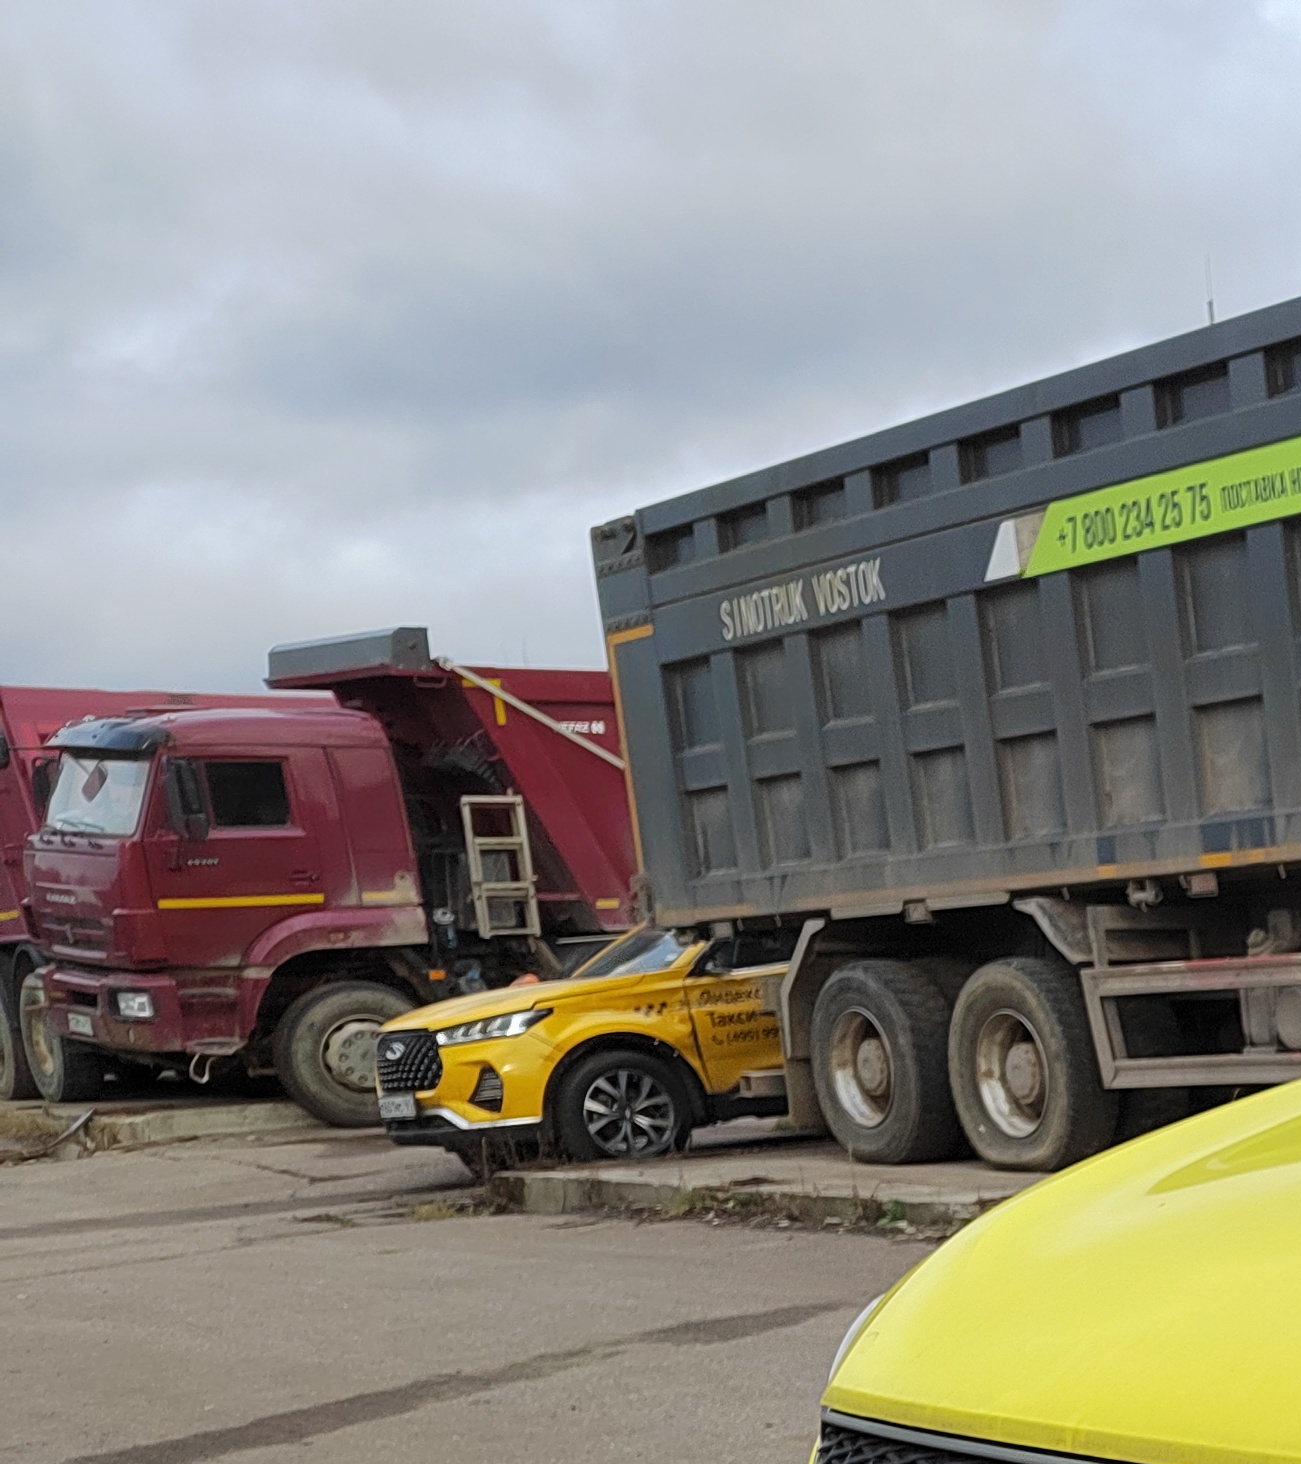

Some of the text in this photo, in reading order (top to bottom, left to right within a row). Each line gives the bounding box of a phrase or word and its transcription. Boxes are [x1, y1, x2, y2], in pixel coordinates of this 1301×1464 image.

[1057, 515, 1077, 553] +7
[1082, 507, 1117, 551] 800
[1119, 497, 1155, 541] 234
[1158, 490, 1184, 532] 25
[1186, 482, 1212, 525] 75
[1219, 469, 1288, 514] ПОСТАВКА
[720, 557, 886, 641] SINOTRUK VOSTOK
